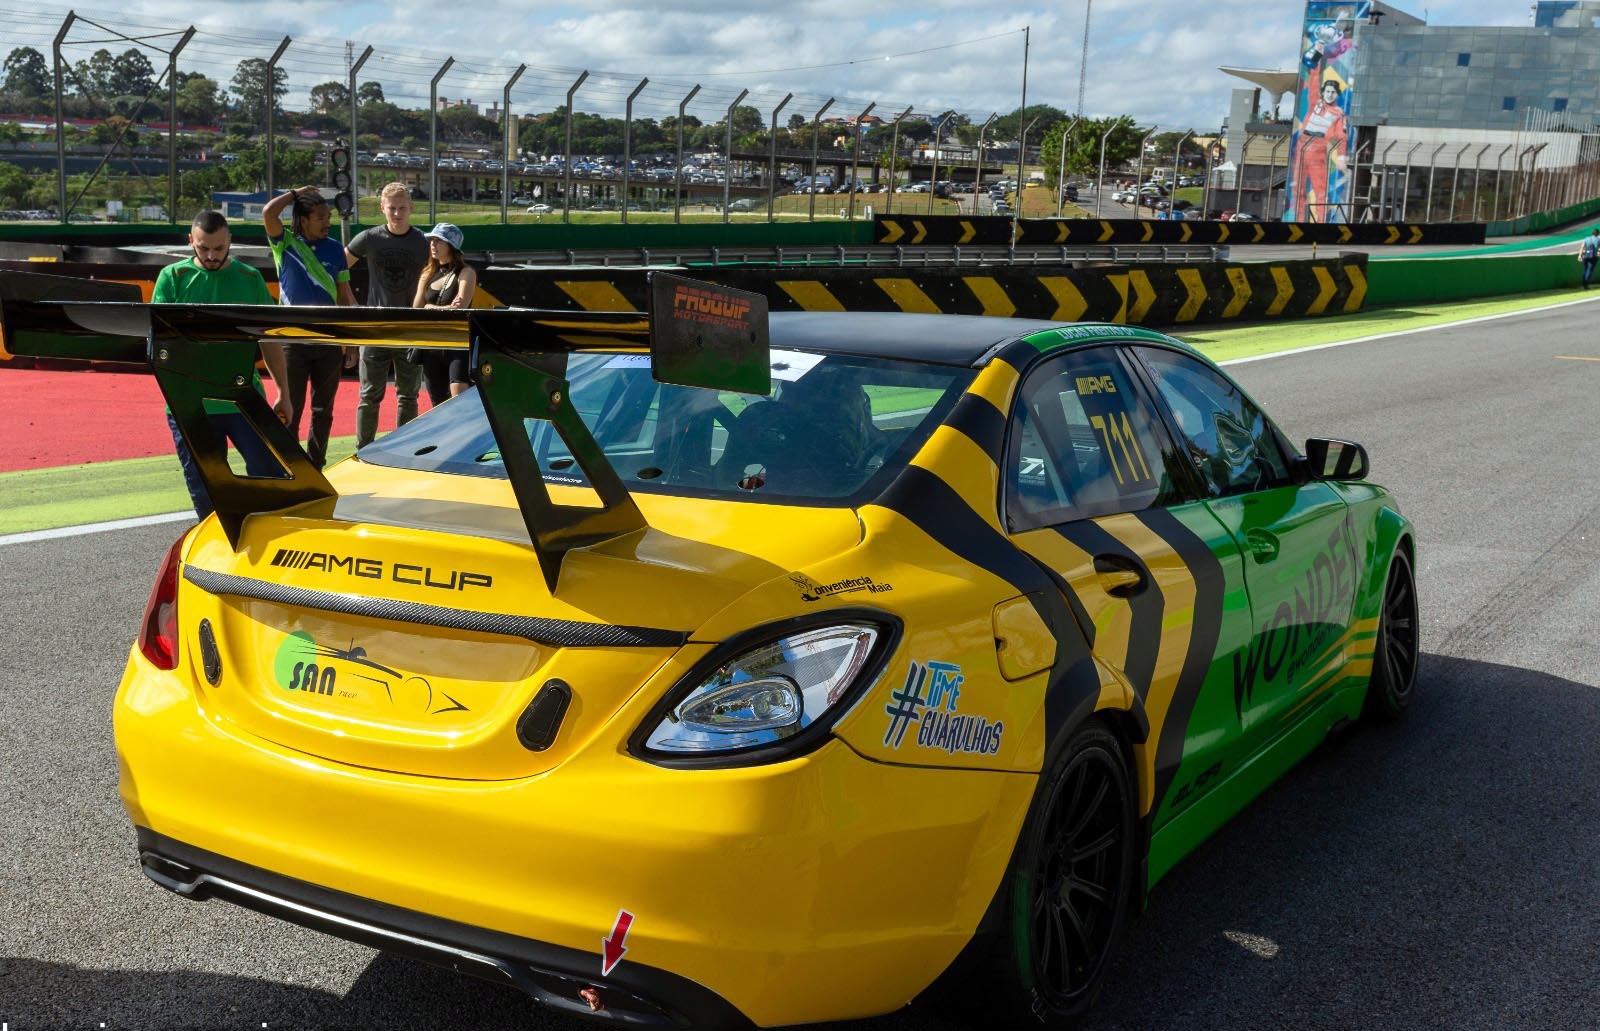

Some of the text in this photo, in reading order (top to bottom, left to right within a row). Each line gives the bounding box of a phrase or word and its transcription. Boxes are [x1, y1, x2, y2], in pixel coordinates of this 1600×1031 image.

[673, 310, 751, 331] MOTORSPORT
[1055, 328, 1089, 340] LUCAS
[1088, 375, 1117, 394] AMG
[1089, 411, 1151, 485] 711
[304, 552, 493, 592] AMG CUP
[866, 582, 894, 595] Maia
[289, 662, 359, 700] SAN race
[917, 710, 1005, 755] GUARULHOS
